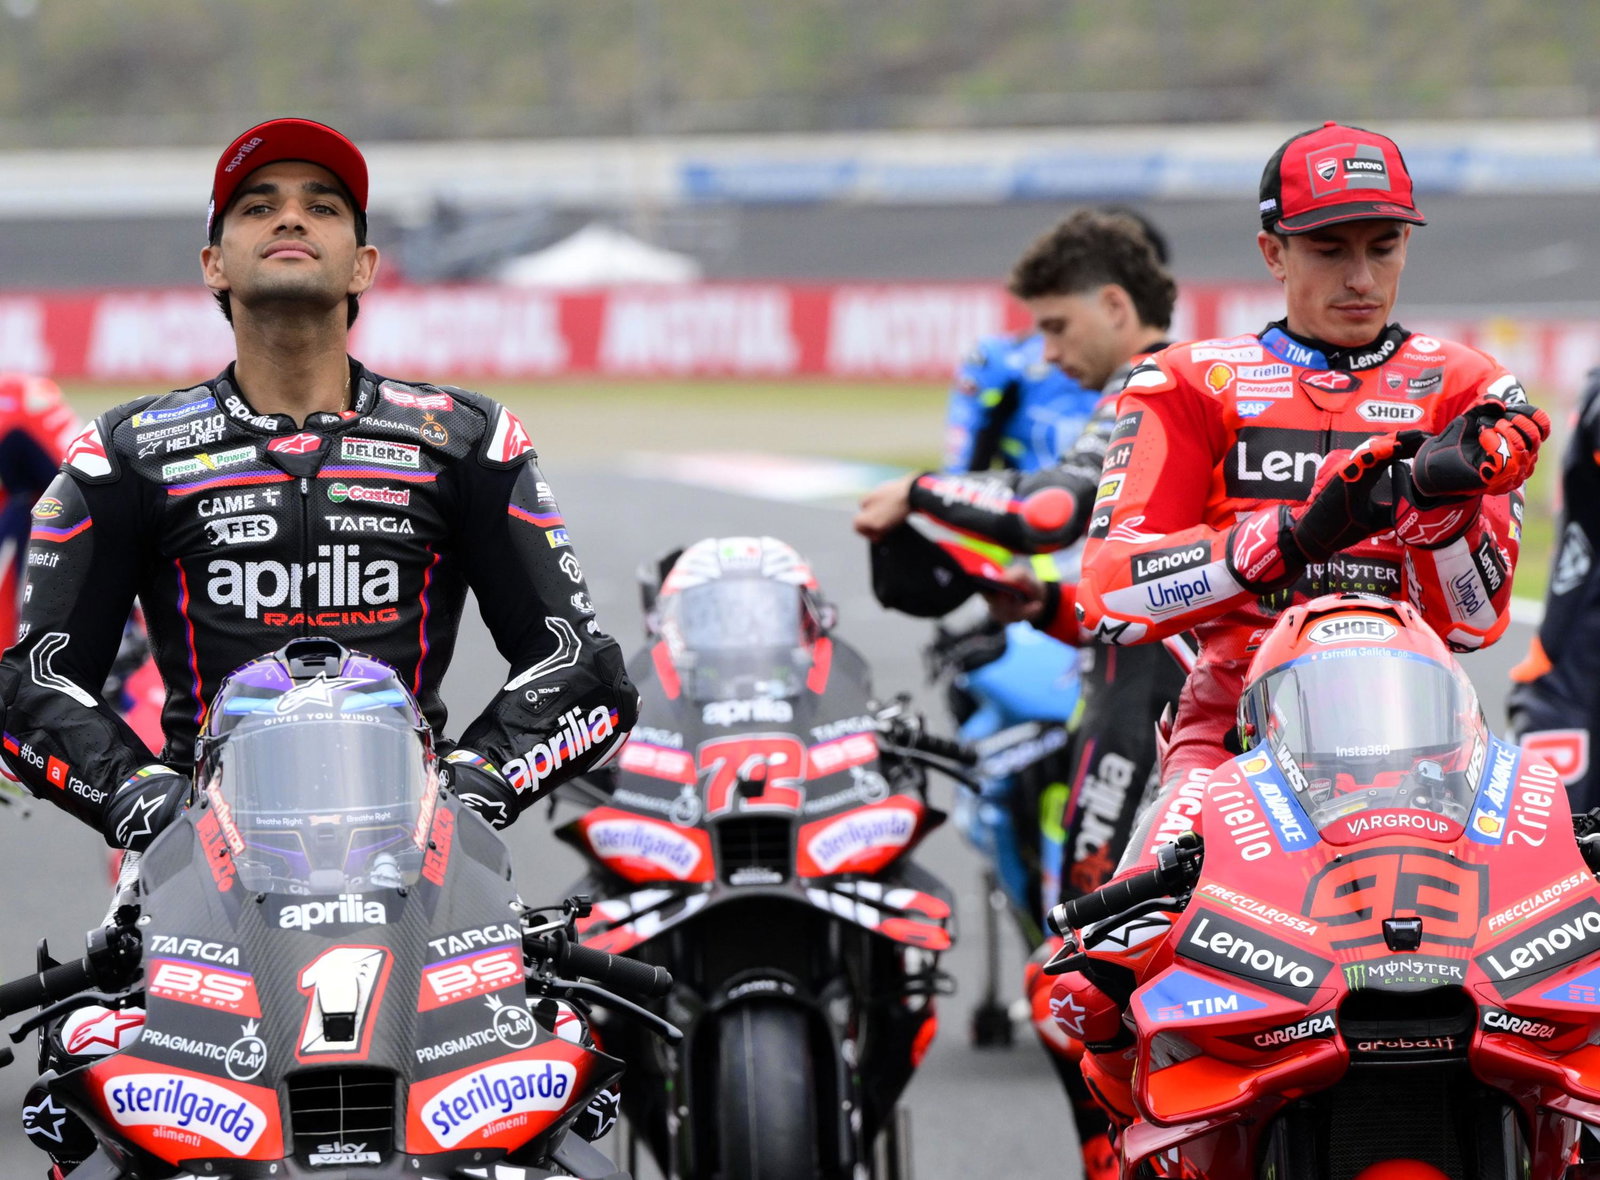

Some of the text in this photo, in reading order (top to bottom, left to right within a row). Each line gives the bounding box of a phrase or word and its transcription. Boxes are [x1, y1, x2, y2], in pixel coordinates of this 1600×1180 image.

[225, 137, 263, 173] aprilia
[1346, 160, 1383, 171] Lenovo
[1286, 343, 1313, 365] TIM
[1349, 340, 1395, 369] Lenovo
[1253, 365, 1289, 378] riello
[1409, 375, 1440, 388] Lenovo
[1239, 385, 1291, 393] CARRERA
[157, 402, 209, 419] MICHELIN
[225, 395, 279, 431] aprilia
[1238, 402, 1266, 415] SAP
[1367, 405, 1415, 419] SHOEI
[137, 414, 226, 442] SUPERTECH R10
[166, 429, 226, 453] HELMET
[359, 417, 446, 441] PRAGMATIC PLAY
[164, 464, 197, 477] Green
[216, 450, 252, 465] Power
[1237, 441, 1322, 482] Len
[198, 494, 256, 517] CAME
[348, 486, 410, 506] Castrol
[227, 519, 270, 539] FES
[324, 516, 414, 534] TARGA
[1137, 547, 1205, 578] Lenovo
[1478, 542, 1501, 591] Lenovo
[207, 544, 399, 619] aprilia
[1147, 570, 1212, 607] Unipol
[1312, 582, 1387, 591] ENERGY
[1455, 568, 1486, 617] Unipol
[263, 607, 399, 627] RACING
[1321, 620, 1385, 639] SHOEI
[264, 712, 381, 726] GIVES YOU WINGS
[702, 698, 794, 727] aprilia
[501, 704, 614, 796] aprilia
[1336, 744, 1390, 757] Insta360
[20, 743, 44, 769] #be
[68, 776, 109, 804] racer
[1277, 745, 1308, 792] WRS
[1514, 764, 1559, 830] riello
[256, 817, 304, 827] Breathe Right
[346, 811, 391, 823] Breathe Right
[1213, 790, 1272, 861] riello
[1255, 781, 1307, 843] ADVANCE
[279, 894, 386, 931] aprilia
[1201, 883, 1319, 936] FRECCIAROSSA
[1306, 848, 1486, 948] 93
[1488, 871, 1590, 931] FRECCIAROSSA
[150, 935, 240, 966] TARGA
[428, 923, 522, 957] TARGA
[1190, 917, 1314, 988] Lenovo
[1487, 910, 1600, 980] Lenovo
[152, 964, 247, 1002] BS
[426, 952, 518, 996] BS
[1368, 958, 1463, 980] MONSTER
[1384, 976, 1450, 985] ENERGY
[437, 973, 523, 1003] BATTERY
[298, 945, 392, 1062] 1
[1187, 994, 1239, 1016] TIM
[1253, 1015, 1336, 1047] CARRERA
[1484, 1011, 1556, 1039] CARRERA
[141, 1029, 264, 1069] PRAGMATIC PLAY
[415, 1016, 532, 1064] PRAGMATIC PLAY
[112, 1079, 255, 1142] sterilgarda
[431, 1063, 568, 1136] sterilgarda
[152, 1126, 201, 1147] alimenti
[482, 1113, 528, 1139] alimenti
[317, 1141, 368, 1154] sky
